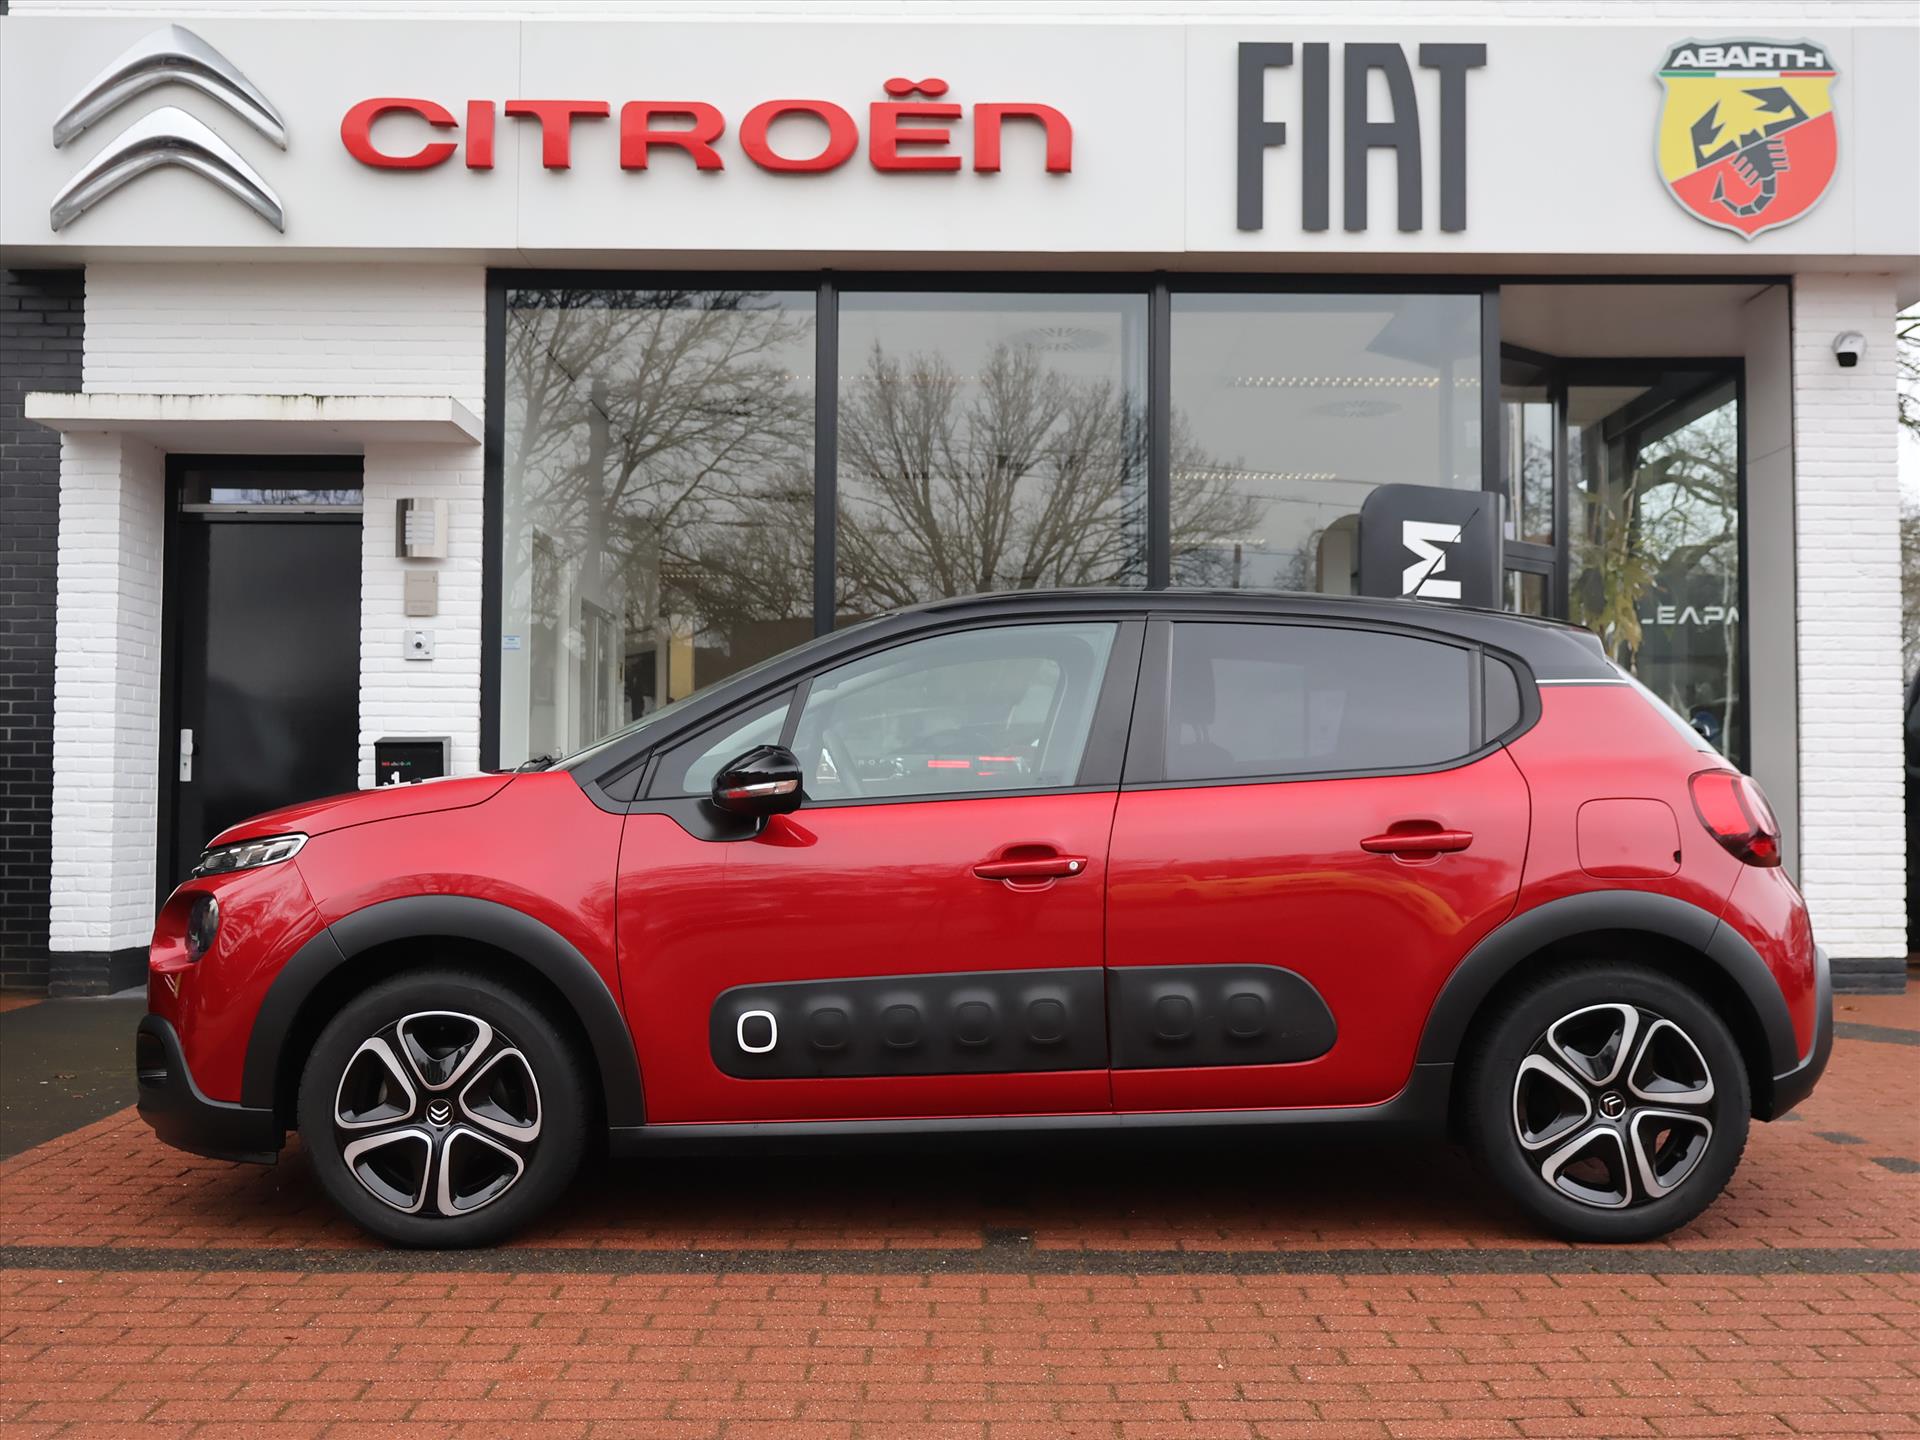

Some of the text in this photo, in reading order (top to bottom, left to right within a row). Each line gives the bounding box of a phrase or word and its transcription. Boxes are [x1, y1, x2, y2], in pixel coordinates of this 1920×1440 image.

[1671, 46, 1825, 68] ABARTH
[340, 77, 1073, 174] CITROËN
[1236, 41, 1487, 232] FIAT
